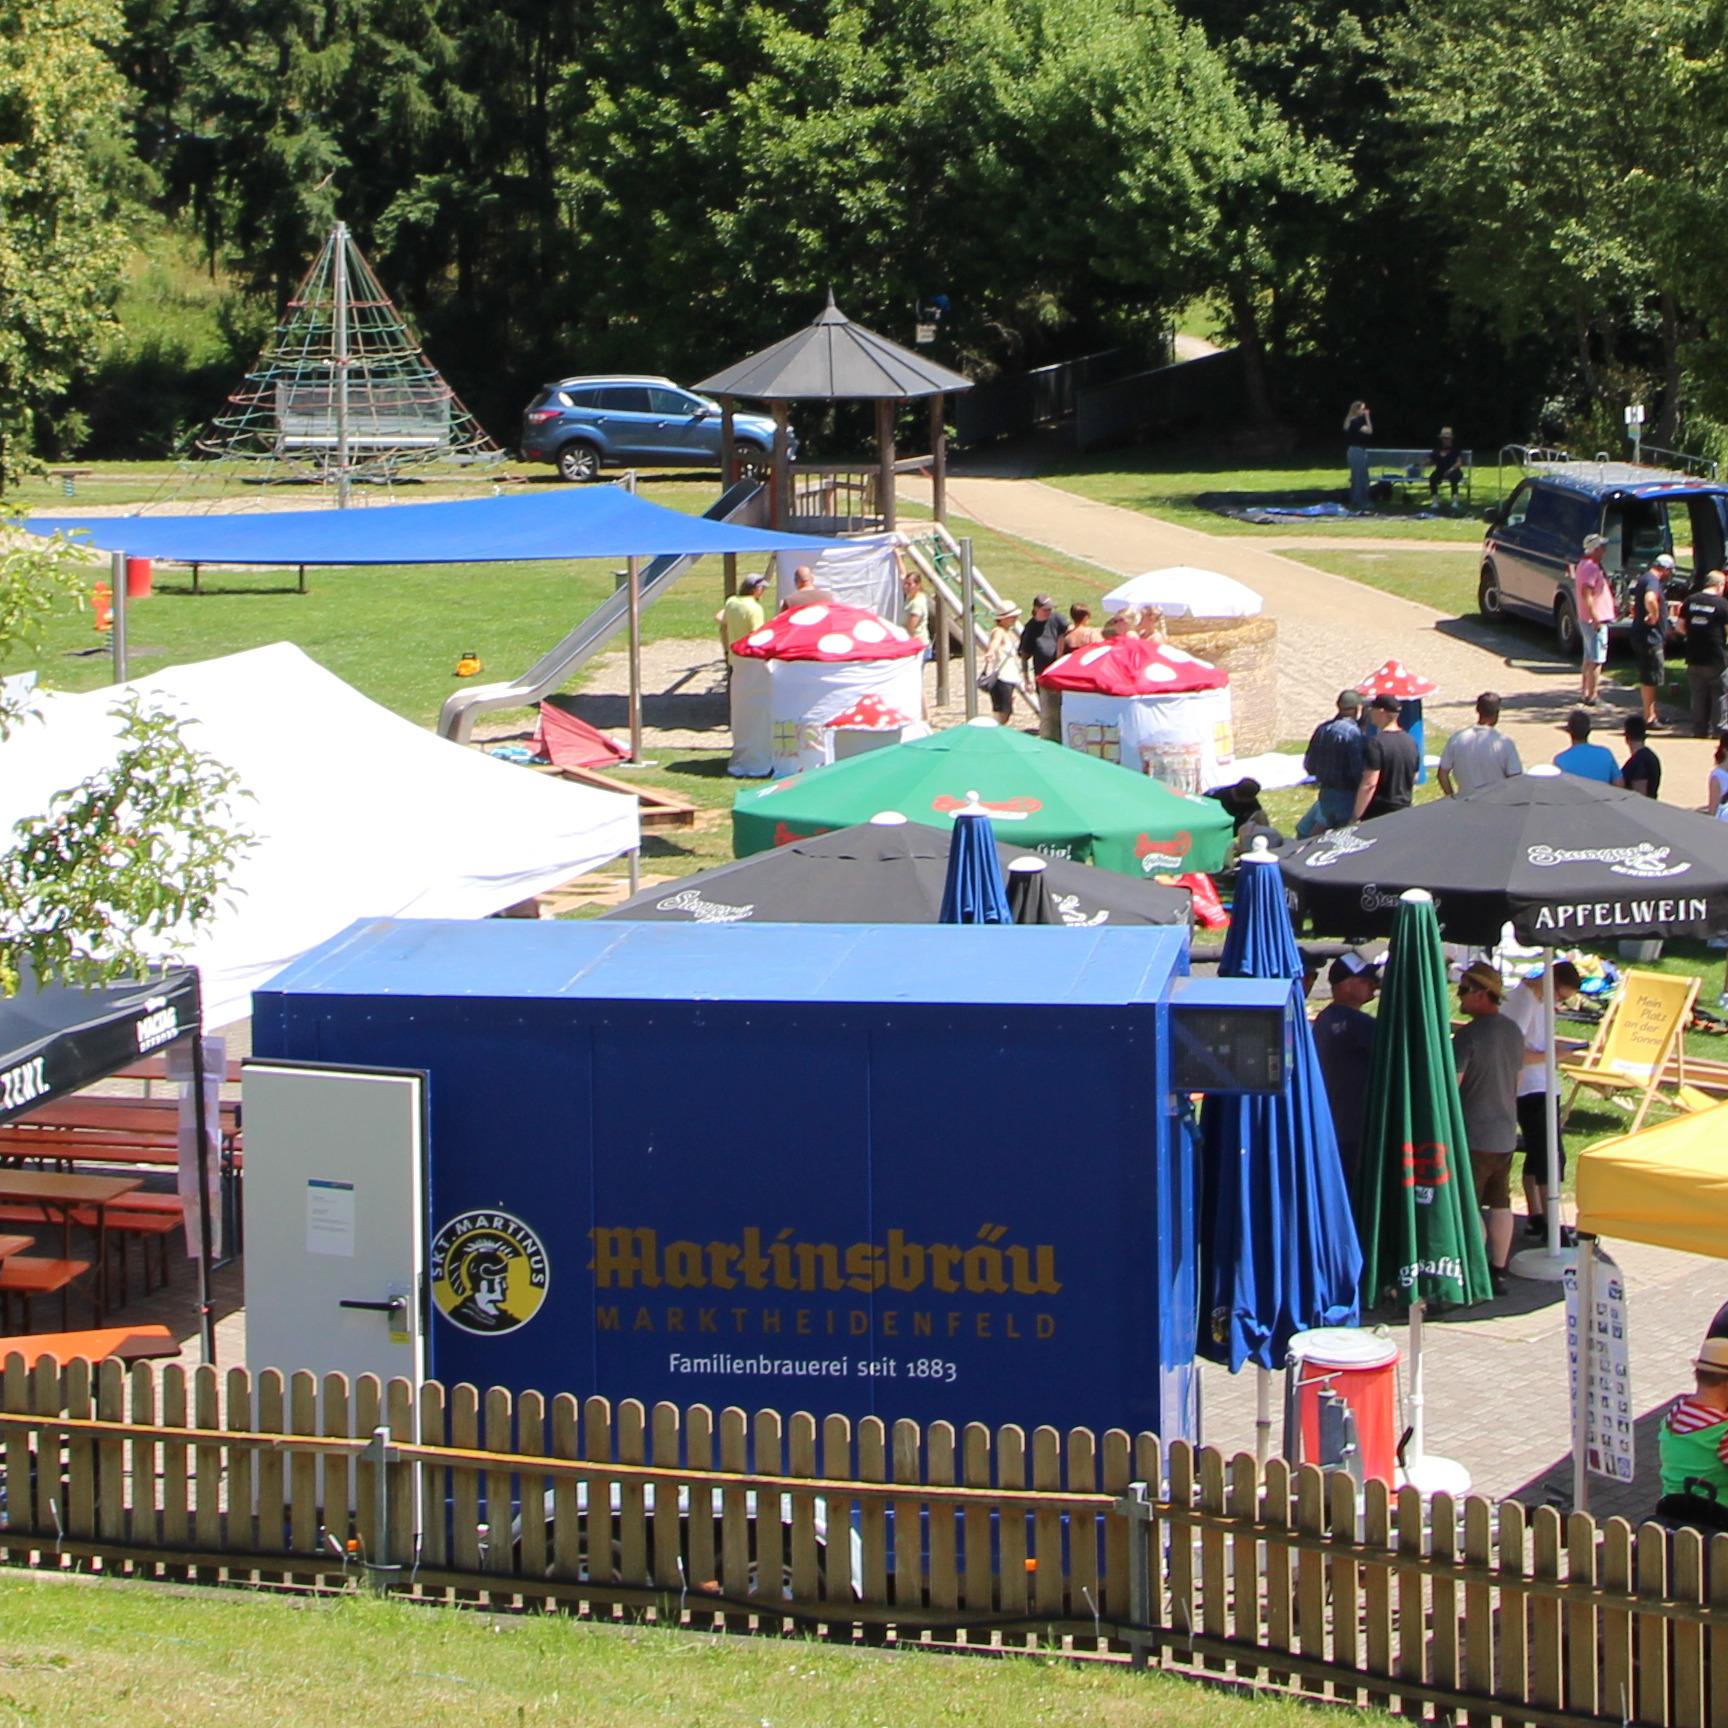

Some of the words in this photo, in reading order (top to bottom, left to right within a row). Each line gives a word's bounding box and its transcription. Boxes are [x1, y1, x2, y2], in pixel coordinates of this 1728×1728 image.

[1535, 898, 1708, 930] APFELWEIN
[1637, 995, 1662, 1009] Mein
[1641, 1008, 1668, 1022] Platz
[1624, 1020, 1638, 1029] an
[1639, 1022, 1659, 1032] der
[587, 1222, 1063, 1295] Martinsbräu
[596, 1305, 1056, 1339] MARKTHEIDENFELD
[670, 1353, 848, 1378] Familienbrauerei
[857, 1357, 897, 1378] seit
[906, 1359, 957, 1382] 1883
